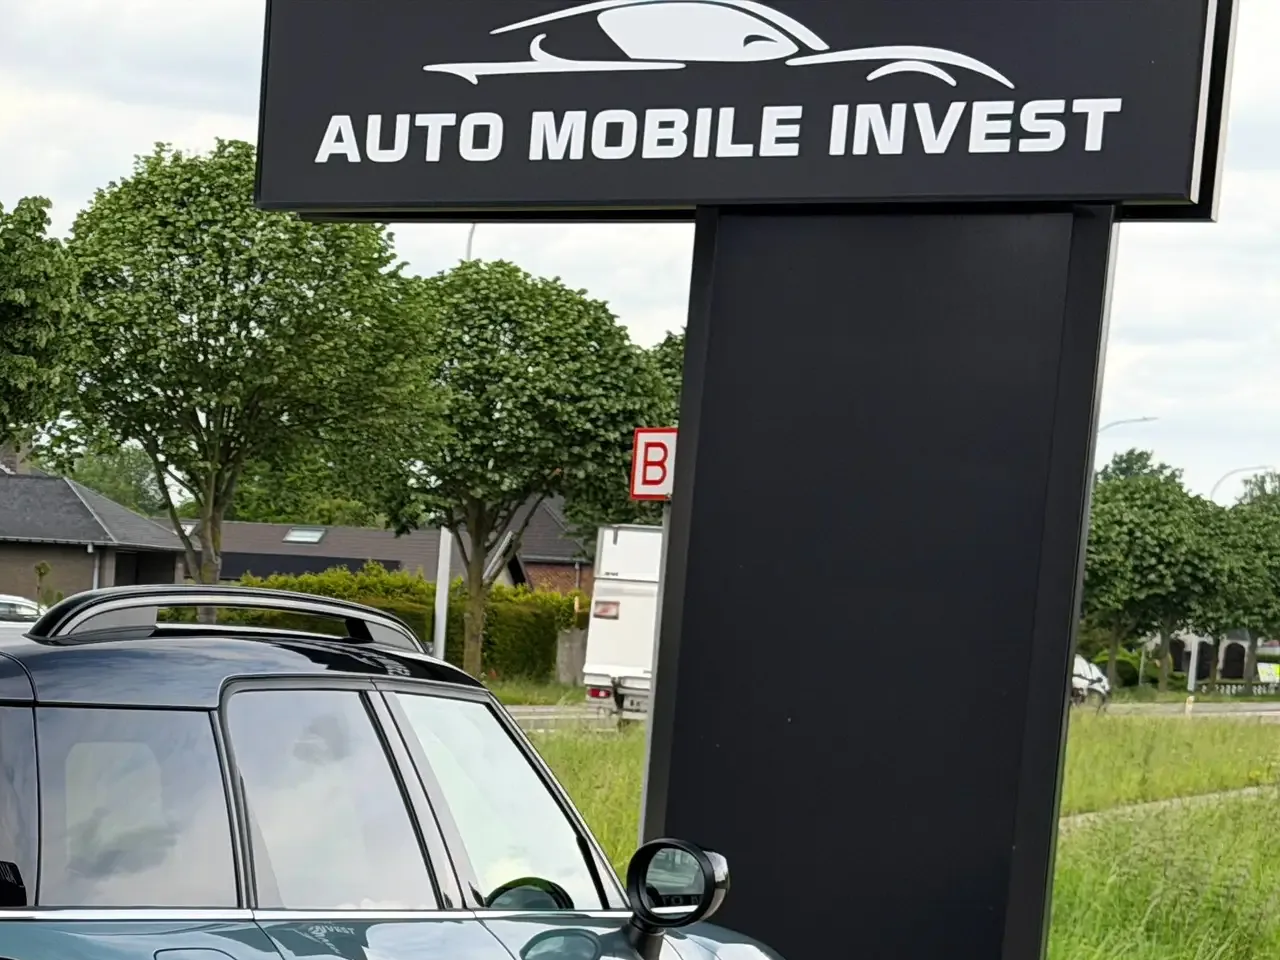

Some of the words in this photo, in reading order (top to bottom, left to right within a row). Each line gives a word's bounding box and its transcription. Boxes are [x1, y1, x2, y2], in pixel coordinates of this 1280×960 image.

[314, 111, 504, 163] AUTO
[528, 105, 803, 161] MOBILE
[828, 97, 1123, 156] INVEST
[642, 442, 668, 485] B
